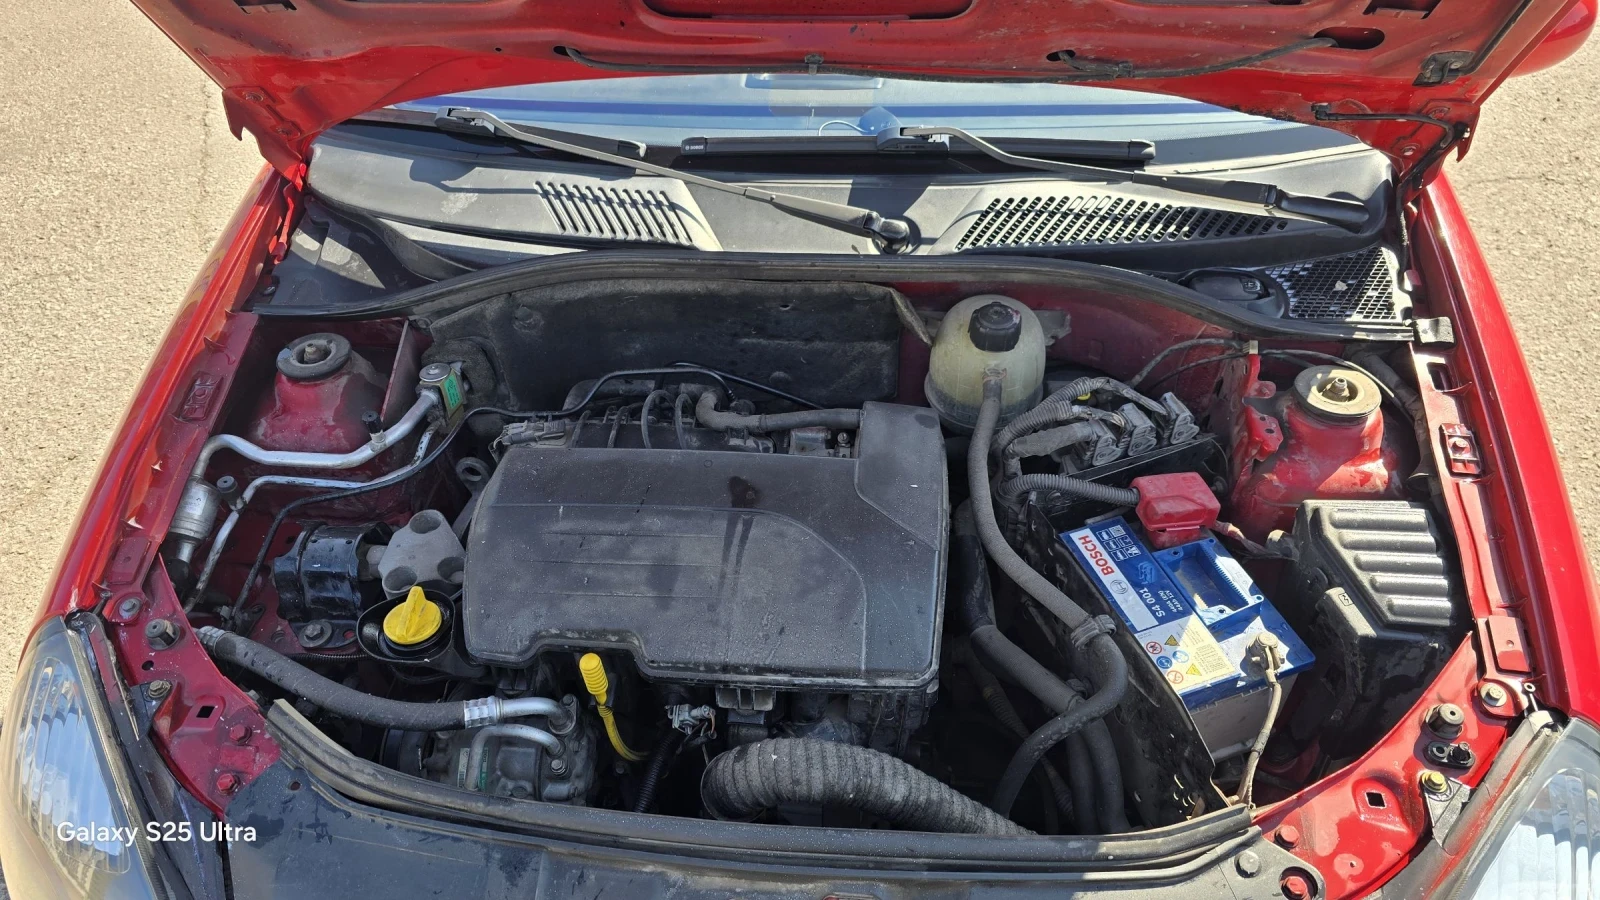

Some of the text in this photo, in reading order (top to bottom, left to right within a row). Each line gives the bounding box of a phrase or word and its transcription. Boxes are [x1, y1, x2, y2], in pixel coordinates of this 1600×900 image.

[1078, 535, 1115, 576] BOSCH
[1139, 587, 1166, 617] S4 001
